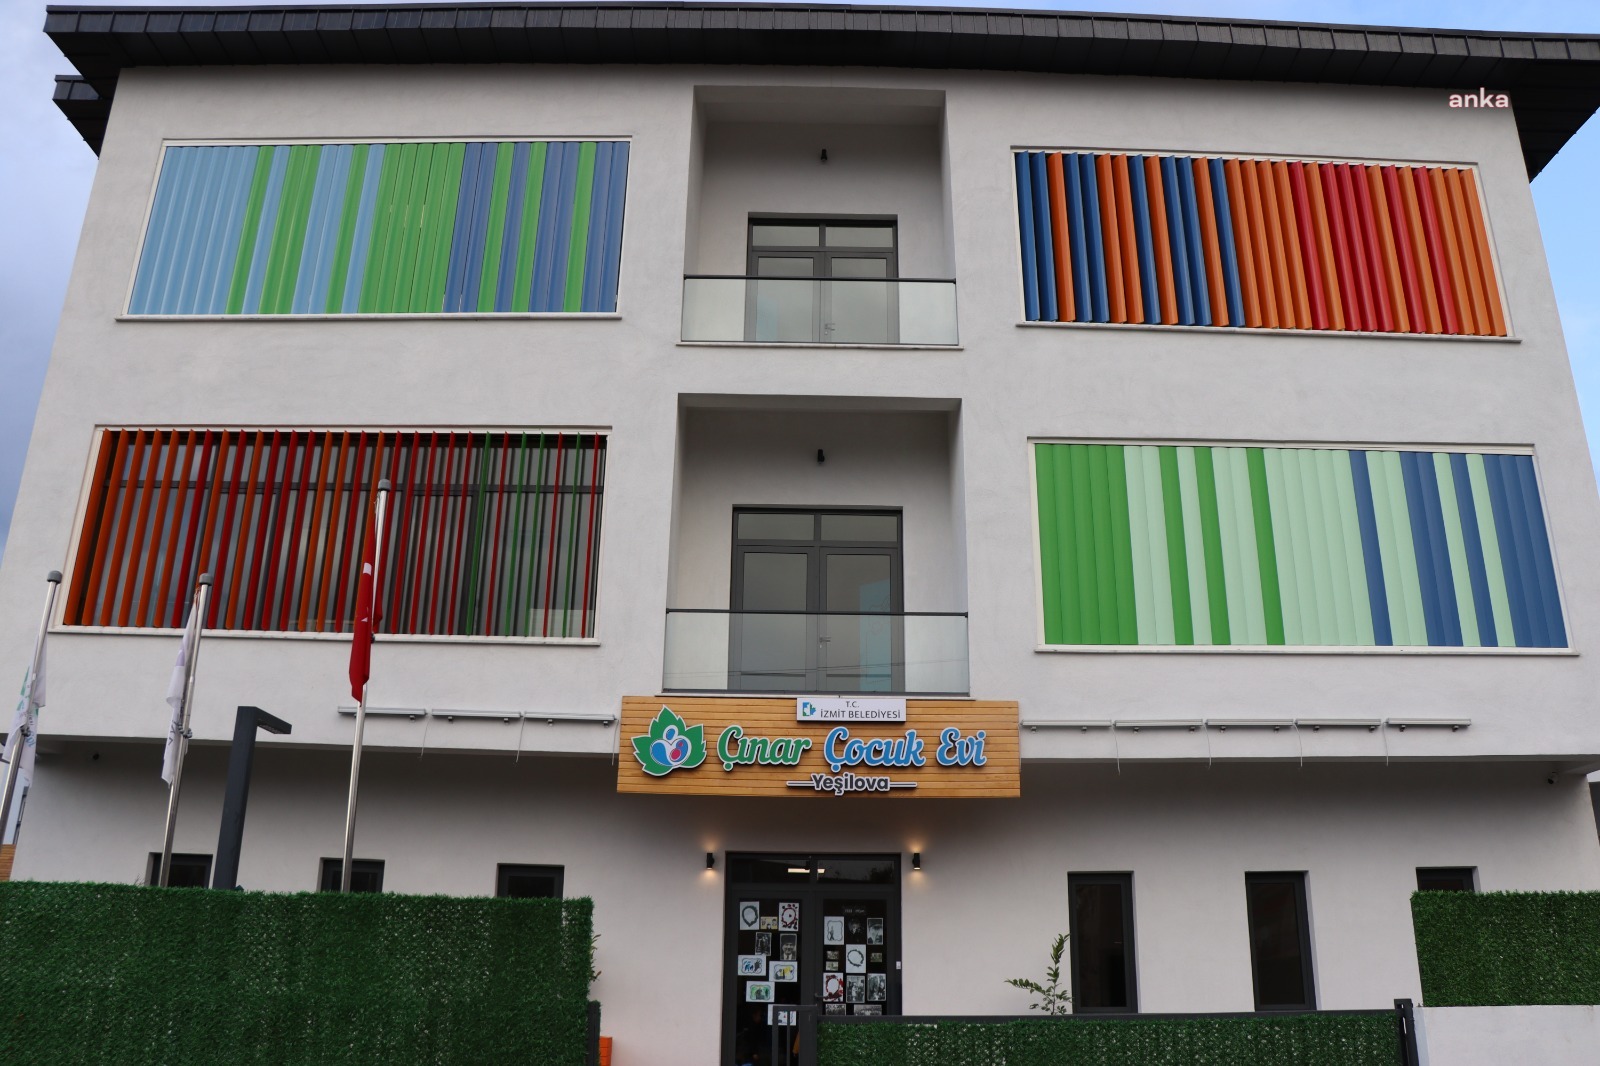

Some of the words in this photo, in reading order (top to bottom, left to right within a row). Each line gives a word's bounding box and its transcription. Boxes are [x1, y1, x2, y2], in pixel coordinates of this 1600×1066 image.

[845, 701, 860, 709] T.C.
[820, 709, 846, 718] İZMİT
[848, 709, 901, 719] BELEDİYESİ
[717, 725, 812, 772] Çınar
[824, 726, 926, 773] Çocuk
[936, 727, 987, 767] Evi
[810, 772, 890, 796] Yeşilova
